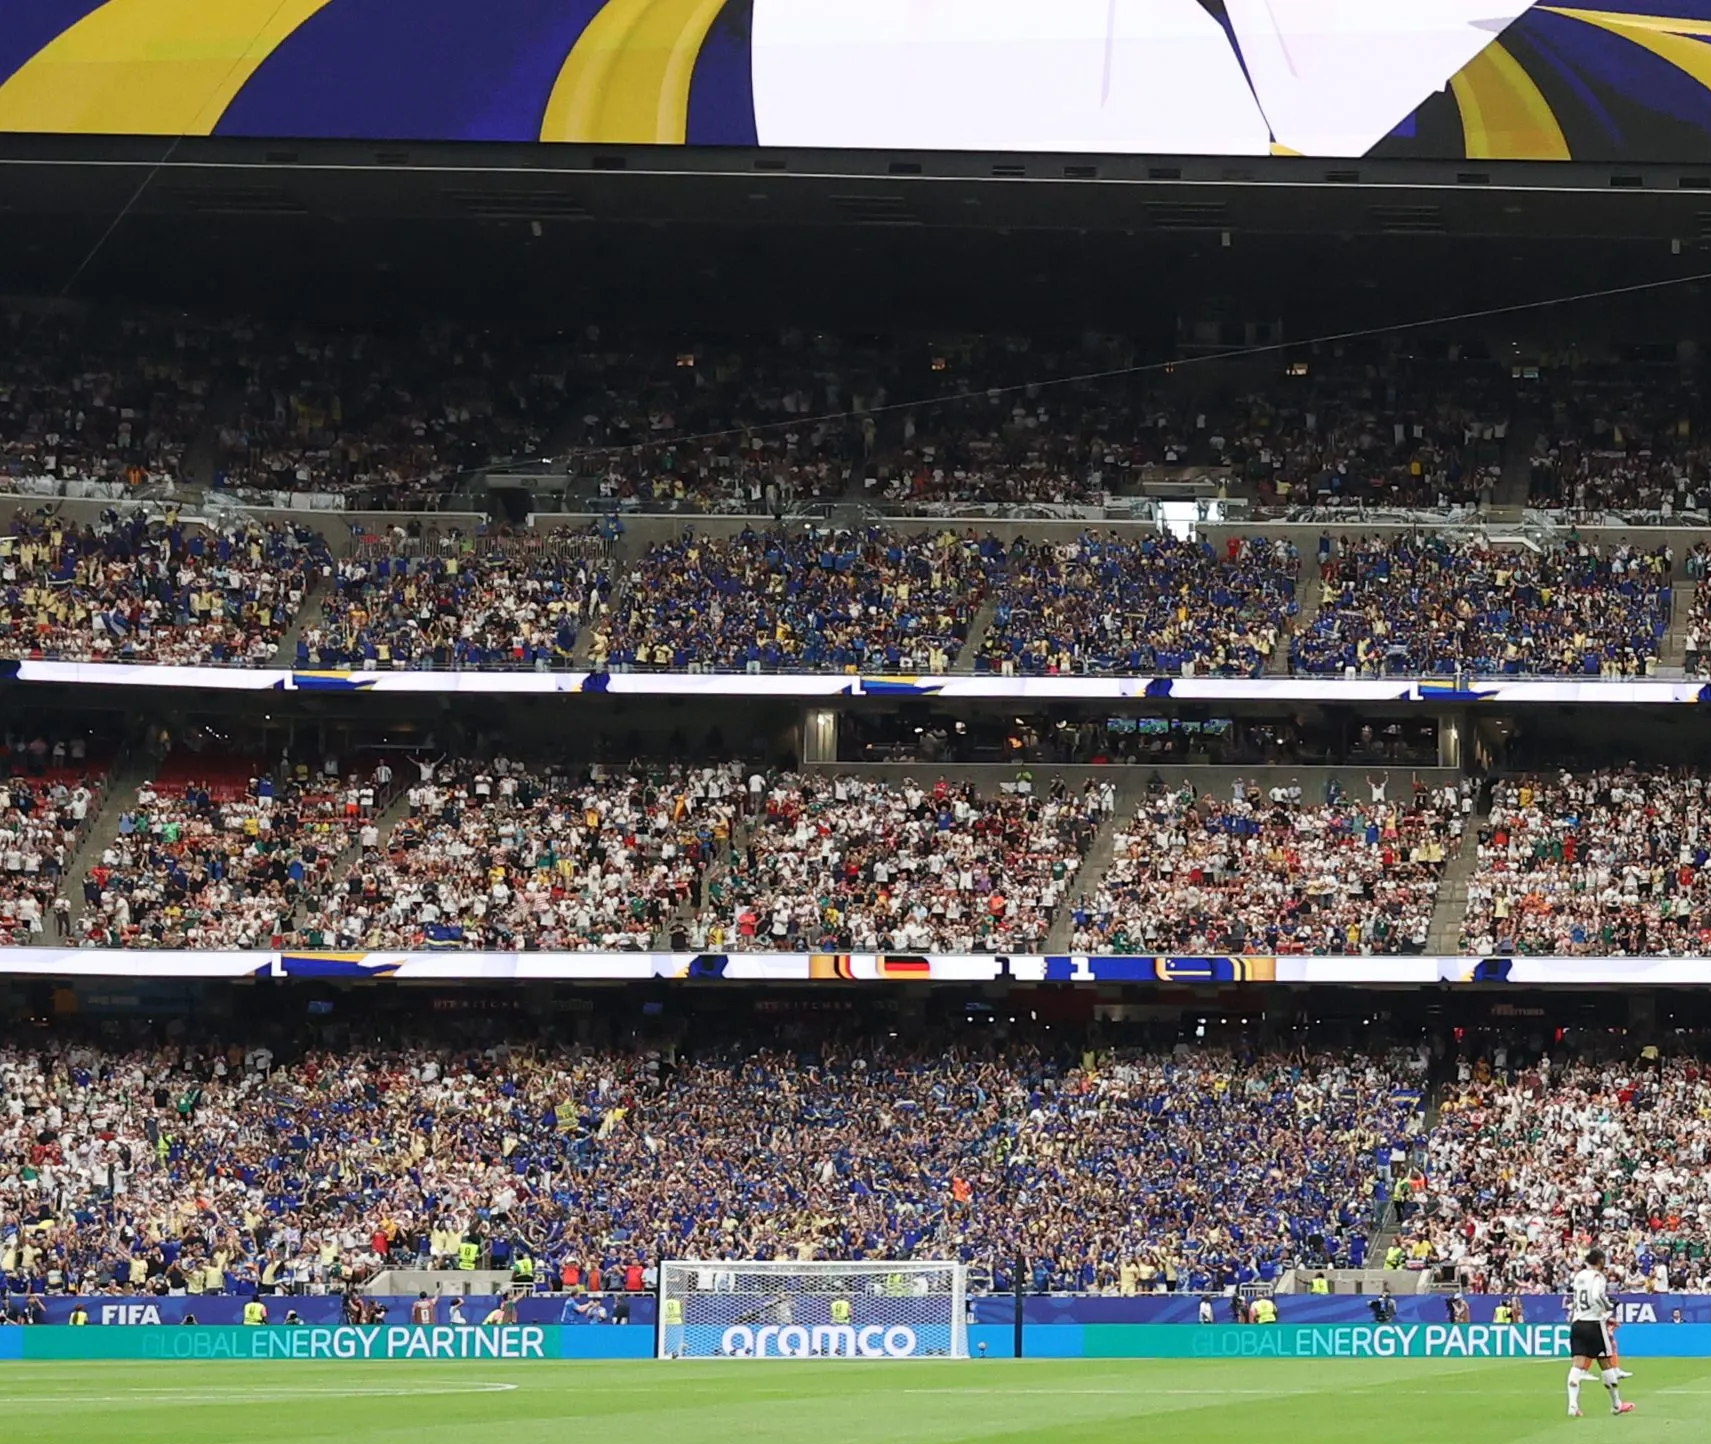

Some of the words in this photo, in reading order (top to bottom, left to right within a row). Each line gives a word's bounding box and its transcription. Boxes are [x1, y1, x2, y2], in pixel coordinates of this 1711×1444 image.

[102, 1304, 162, 1326] FIFA
[1616, 1303, 1657, 1323] IFA
[142, 1331, 247, 1358] GLOBAL
[251, 1326, 382, 1358] ENERGY
[387, 1326, 545, 1358] PARTNER
[721, 1325, 917, 1357] aramco
[1191, 1328, 1291, 1356] GLOBAL
[1295, 1325, 1420, 1357] ENERGY
[1425, 1325, 1572, 1357] PARTNER
